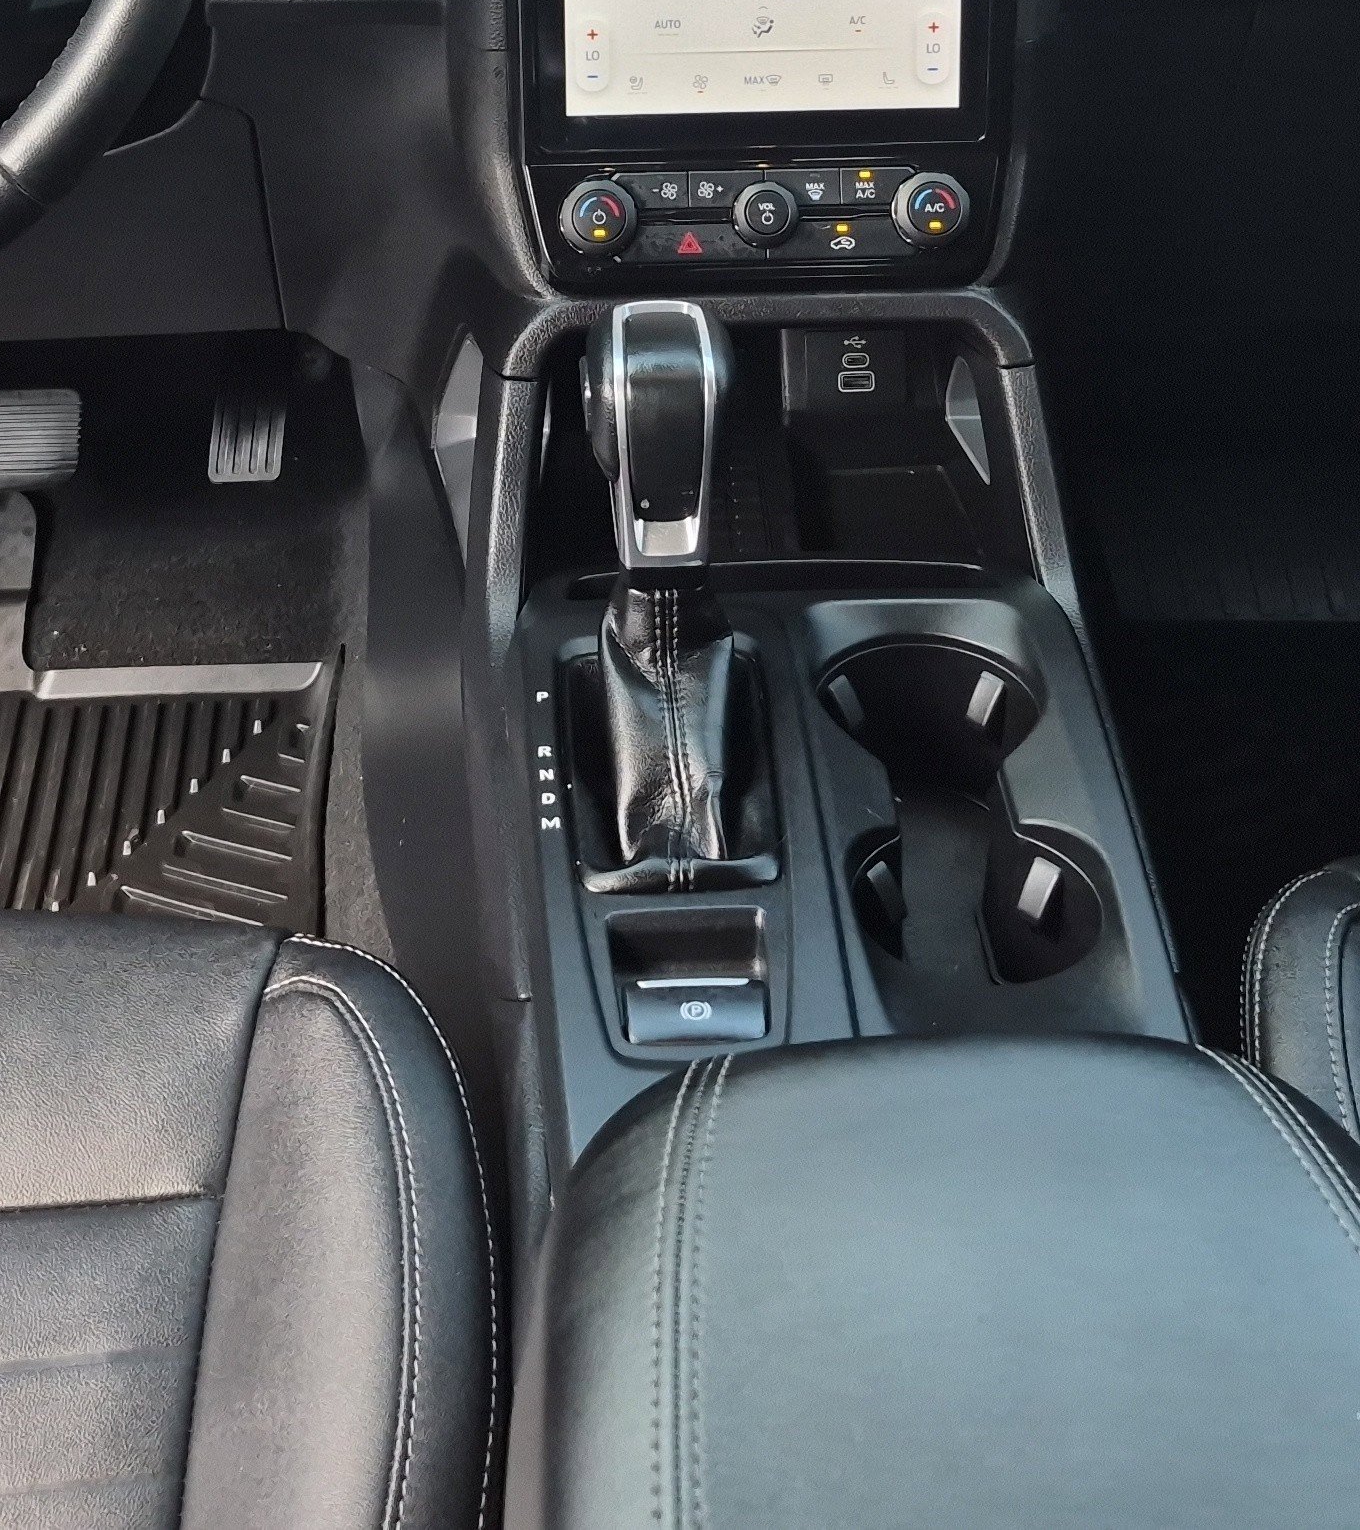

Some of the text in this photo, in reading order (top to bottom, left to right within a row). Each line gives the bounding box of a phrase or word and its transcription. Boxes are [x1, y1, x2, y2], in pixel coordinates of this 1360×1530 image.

[654, 19, 681, 30] AUTO
[849, 15, 866, 25] A/C
[926, 43, 940, 54] LO
[585, 50, 600, 61] LO
[744, 75, 765, 86] MAX
[806, 183, 825, 191] MAX
[855, 182, 875, 190] MAX
[856, 189, 876, 199] A/C
[758, 203, 775, 211] VOL
[924, 203, 945, 213] A/C
[536, 691, 549, 702] P
[537, 745, 552, 757] R
[539, 769, 555, 781] N
[541, 792, 556, 805] D
[541, 816, 561, 830] M
